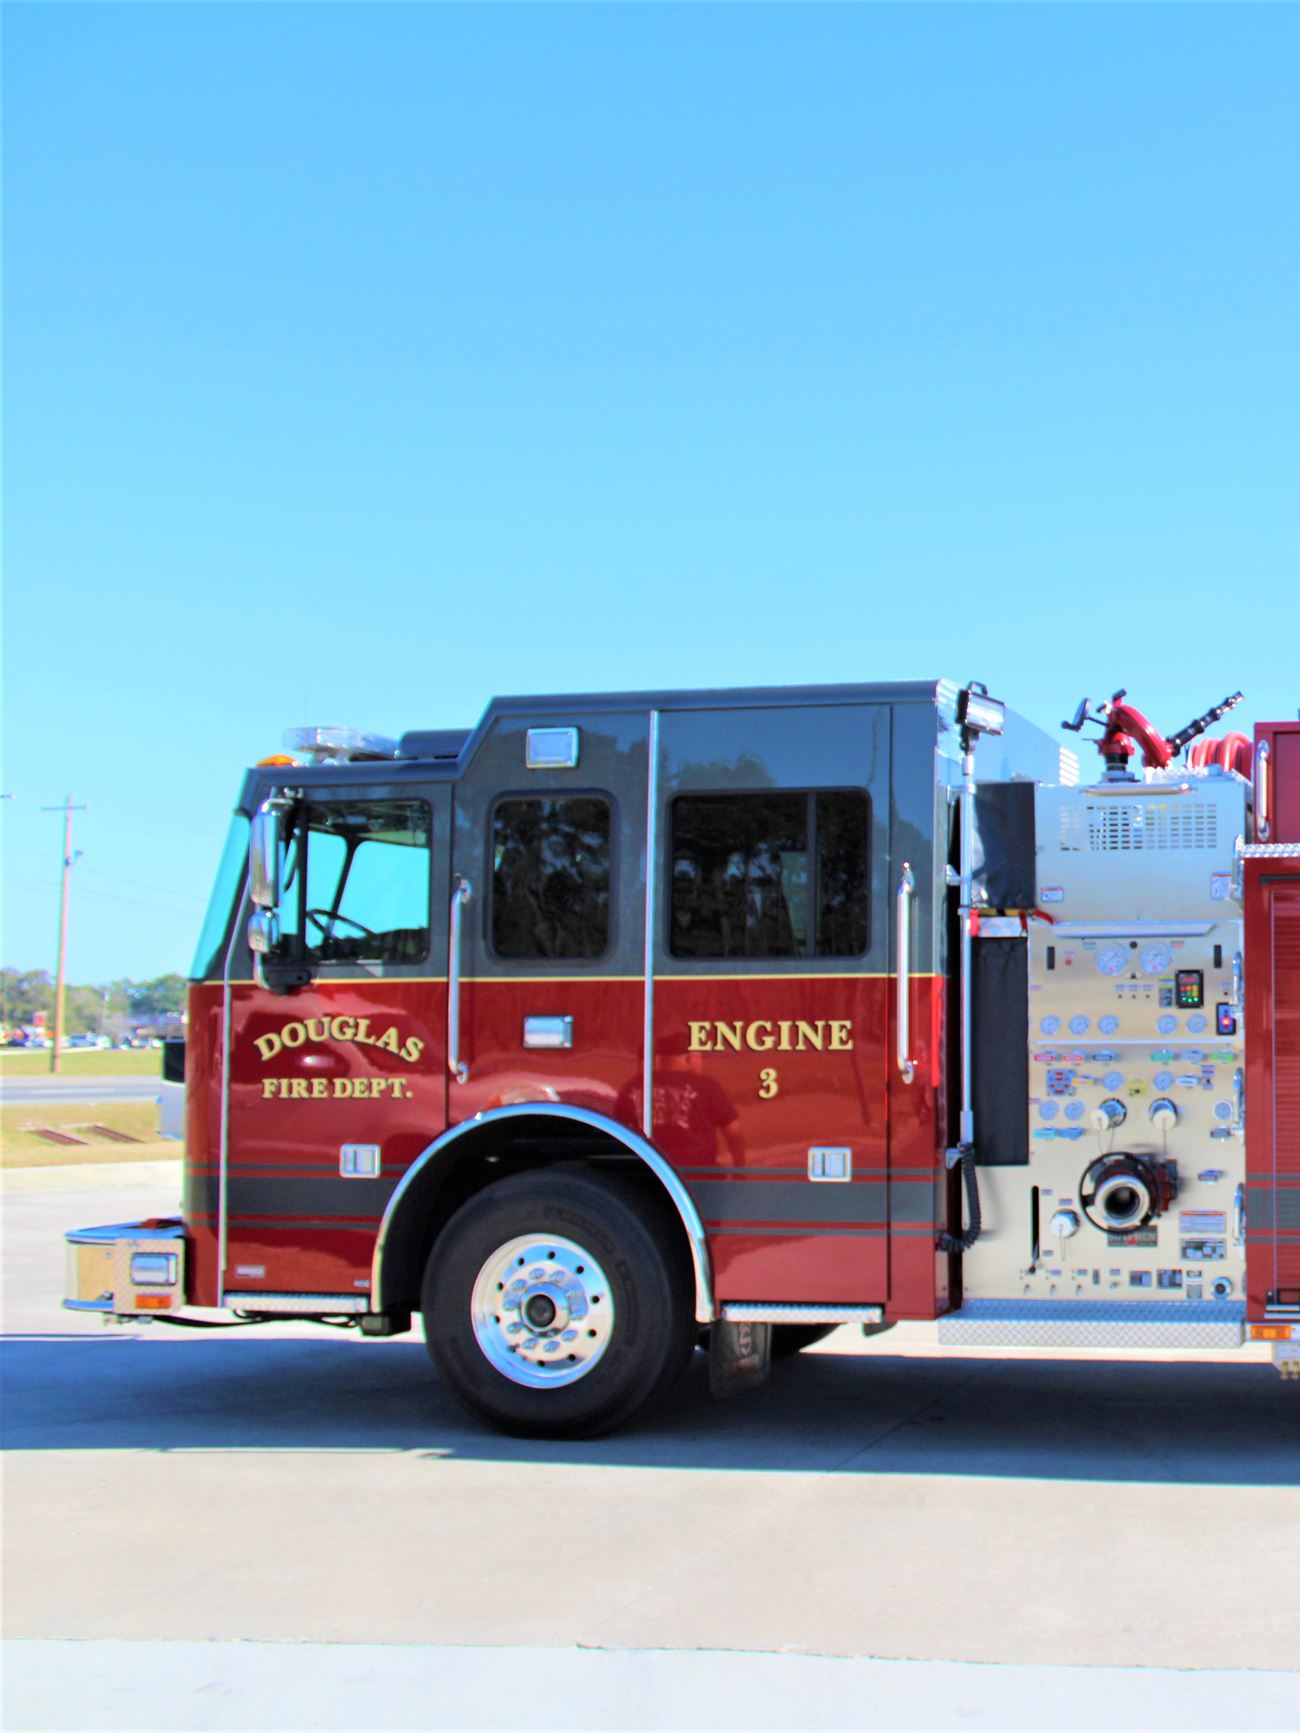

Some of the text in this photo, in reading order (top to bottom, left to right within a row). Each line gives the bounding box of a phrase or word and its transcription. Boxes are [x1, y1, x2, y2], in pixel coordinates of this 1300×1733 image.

[253, 1016, 424, 1062] DOUGLAS
[688, 1020, 854, 1051] ENGINE
[262, 1078, 413, 1098] FIRE DEPT.
[758, 1068, 779, 1098] 3
